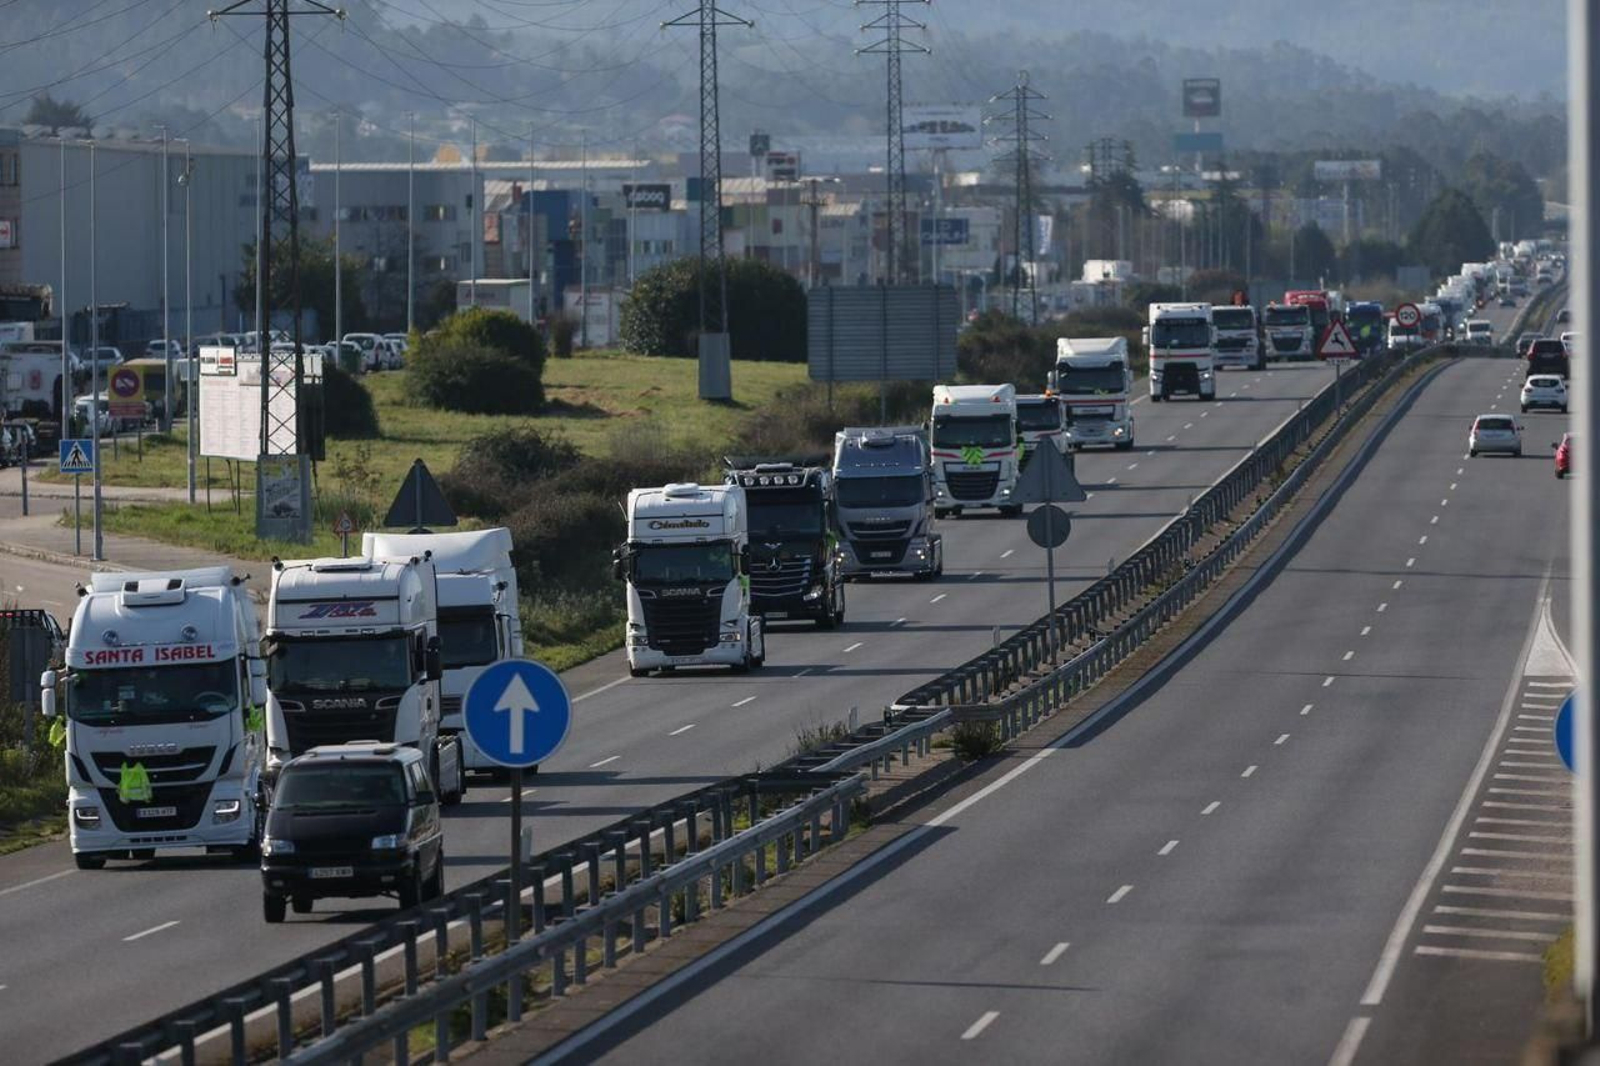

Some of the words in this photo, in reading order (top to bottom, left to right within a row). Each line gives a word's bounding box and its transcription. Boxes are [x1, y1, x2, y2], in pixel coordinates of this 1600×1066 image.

[1400, 310, 1416, 320] 120
[85, 649, 144, 666] SANTA
[155, 645, 216, 661] ISABEL
[312, 698, 367, 710] SCANIA
